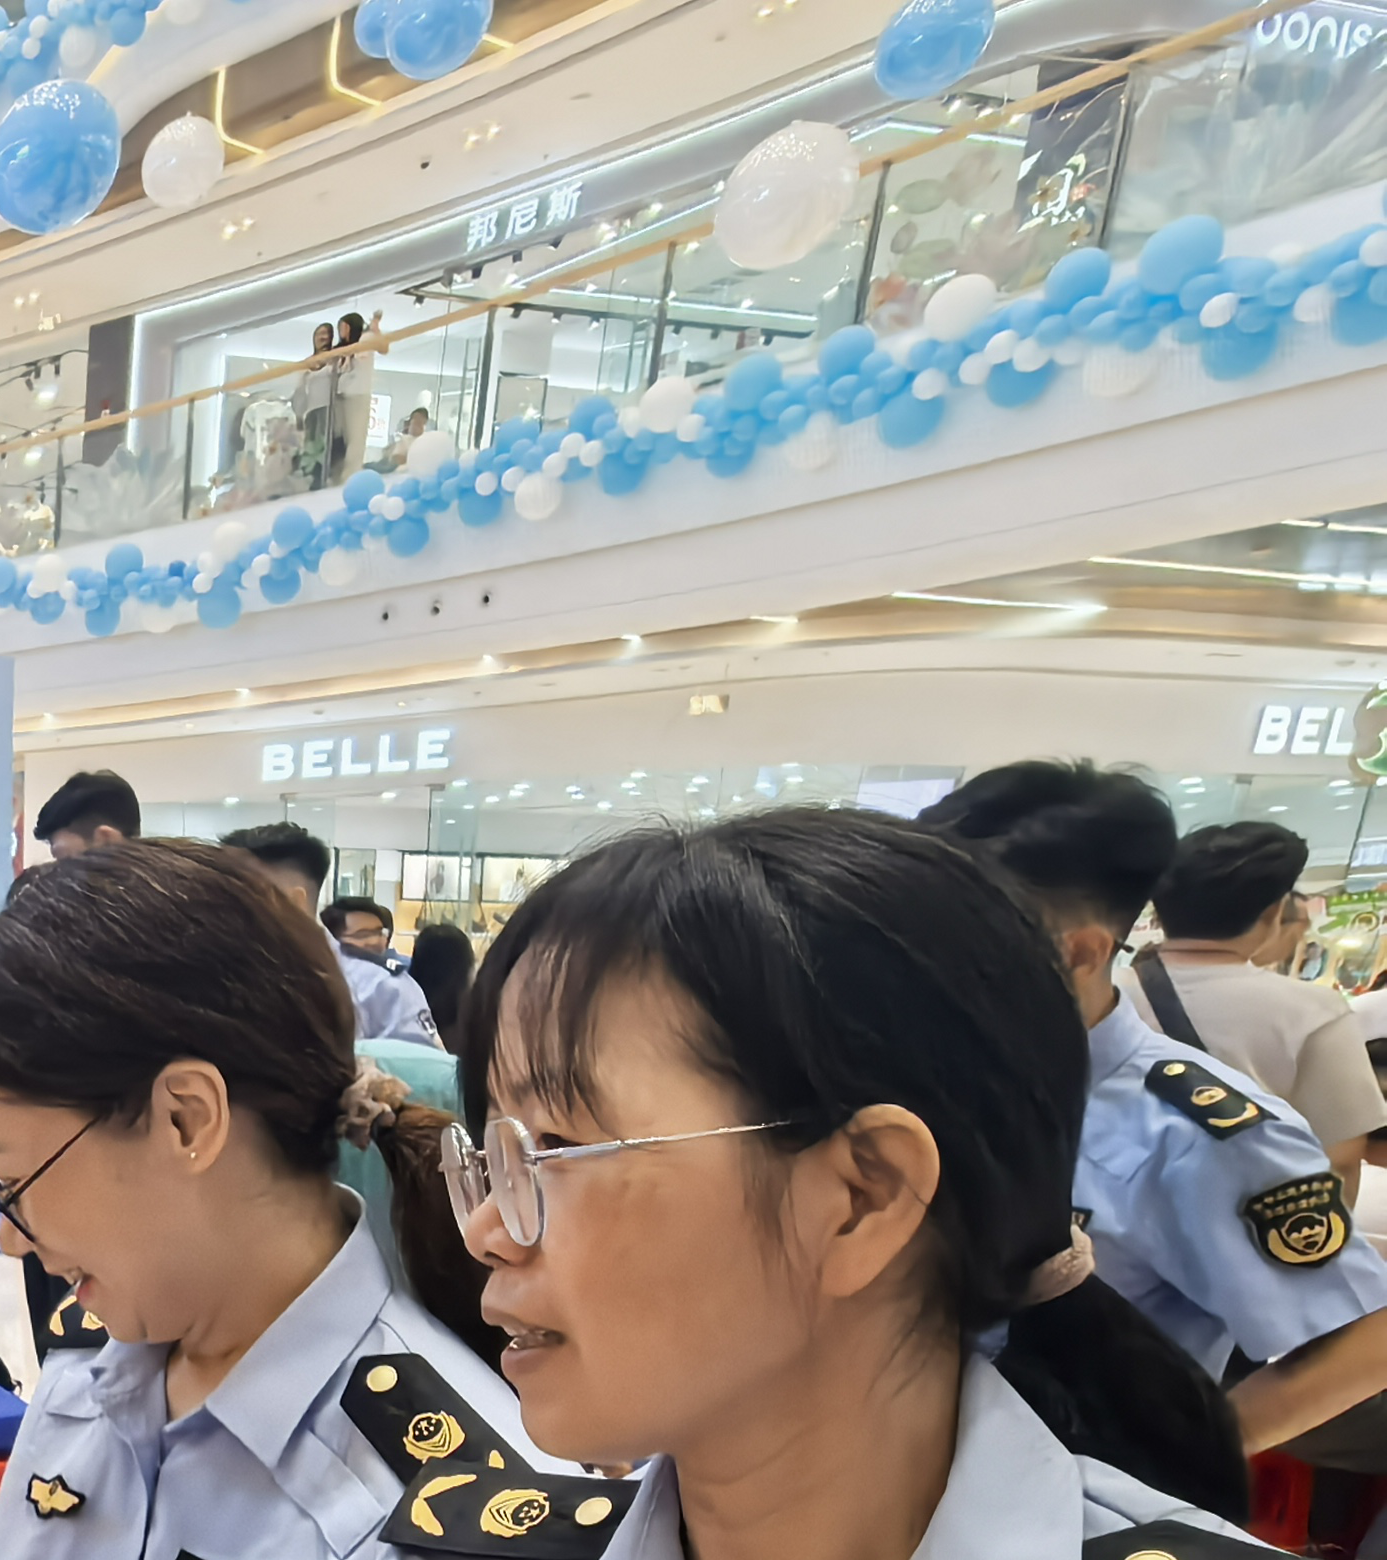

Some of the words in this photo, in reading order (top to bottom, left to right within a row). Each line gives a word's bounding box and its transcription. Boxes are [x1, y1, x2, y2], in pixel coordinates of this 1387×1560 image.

[466, 182, 584, 252] 邦尼斯
[262, 728, 451, 783] BELLE
[1253, 705, 1354, 755] BEL
